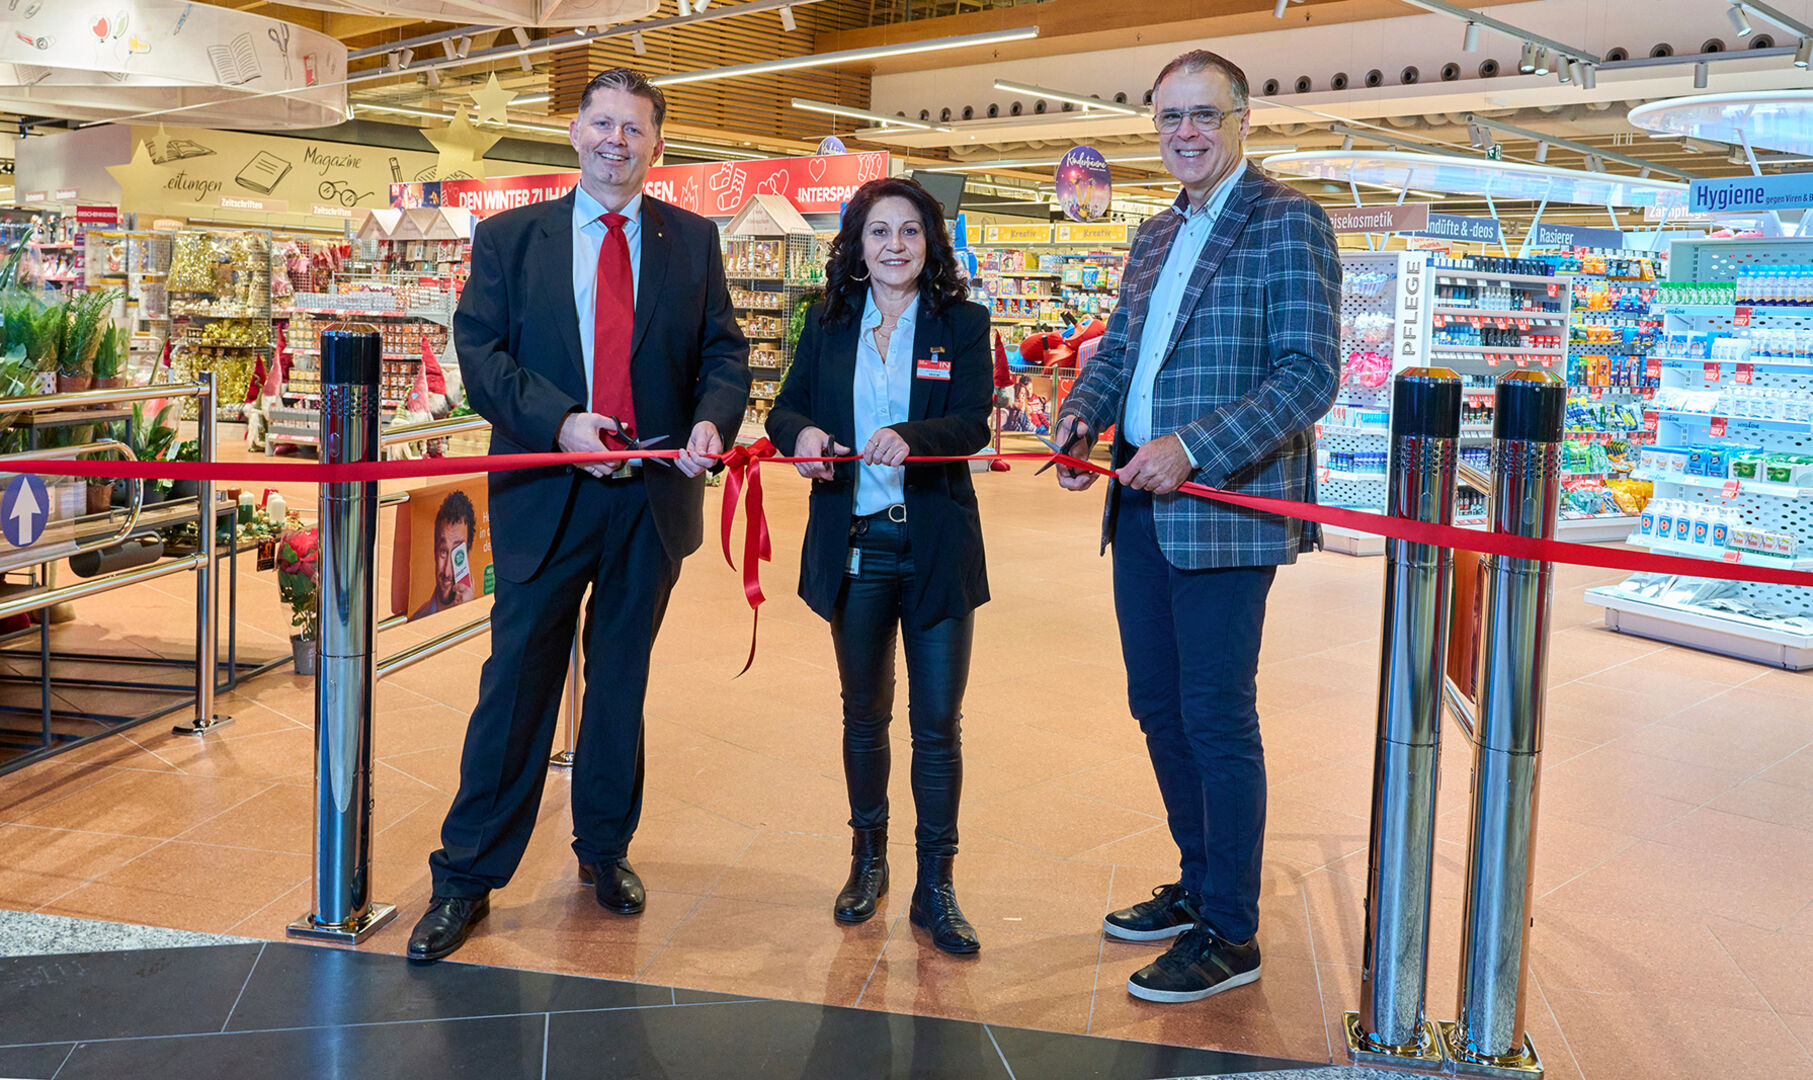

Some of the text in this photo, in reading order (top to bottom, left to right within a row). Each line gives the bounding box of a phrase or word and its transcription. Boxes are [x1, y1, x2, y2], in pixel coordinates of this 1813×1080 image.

[303, 145, 362, 176] Magazine
[163, 170, 223, 202] eitungen
[459, 190, 482, 210] DEN
[483, 188, 530, 210] WINTER
[642, 180, 678, 202] SEN.
[221, 198, 263, 210] Zeitschriften
[1696, 183, 1765, 210] Hygiene
[313, 205, 352, 217] Zeitschriften
[1329, 211, 1394, 230] eisekosmetik
[1010, 228, 1037, 238] Kreativ
[1083, 227, 1112, 238] Kreativ
[1460, 220, 1468, 237] &
[1469, 222, 1494, 239] -deos
[1539, 227, 1574, 245] Rasierer
[1402, 260, 1421, 356] PFLEGE
